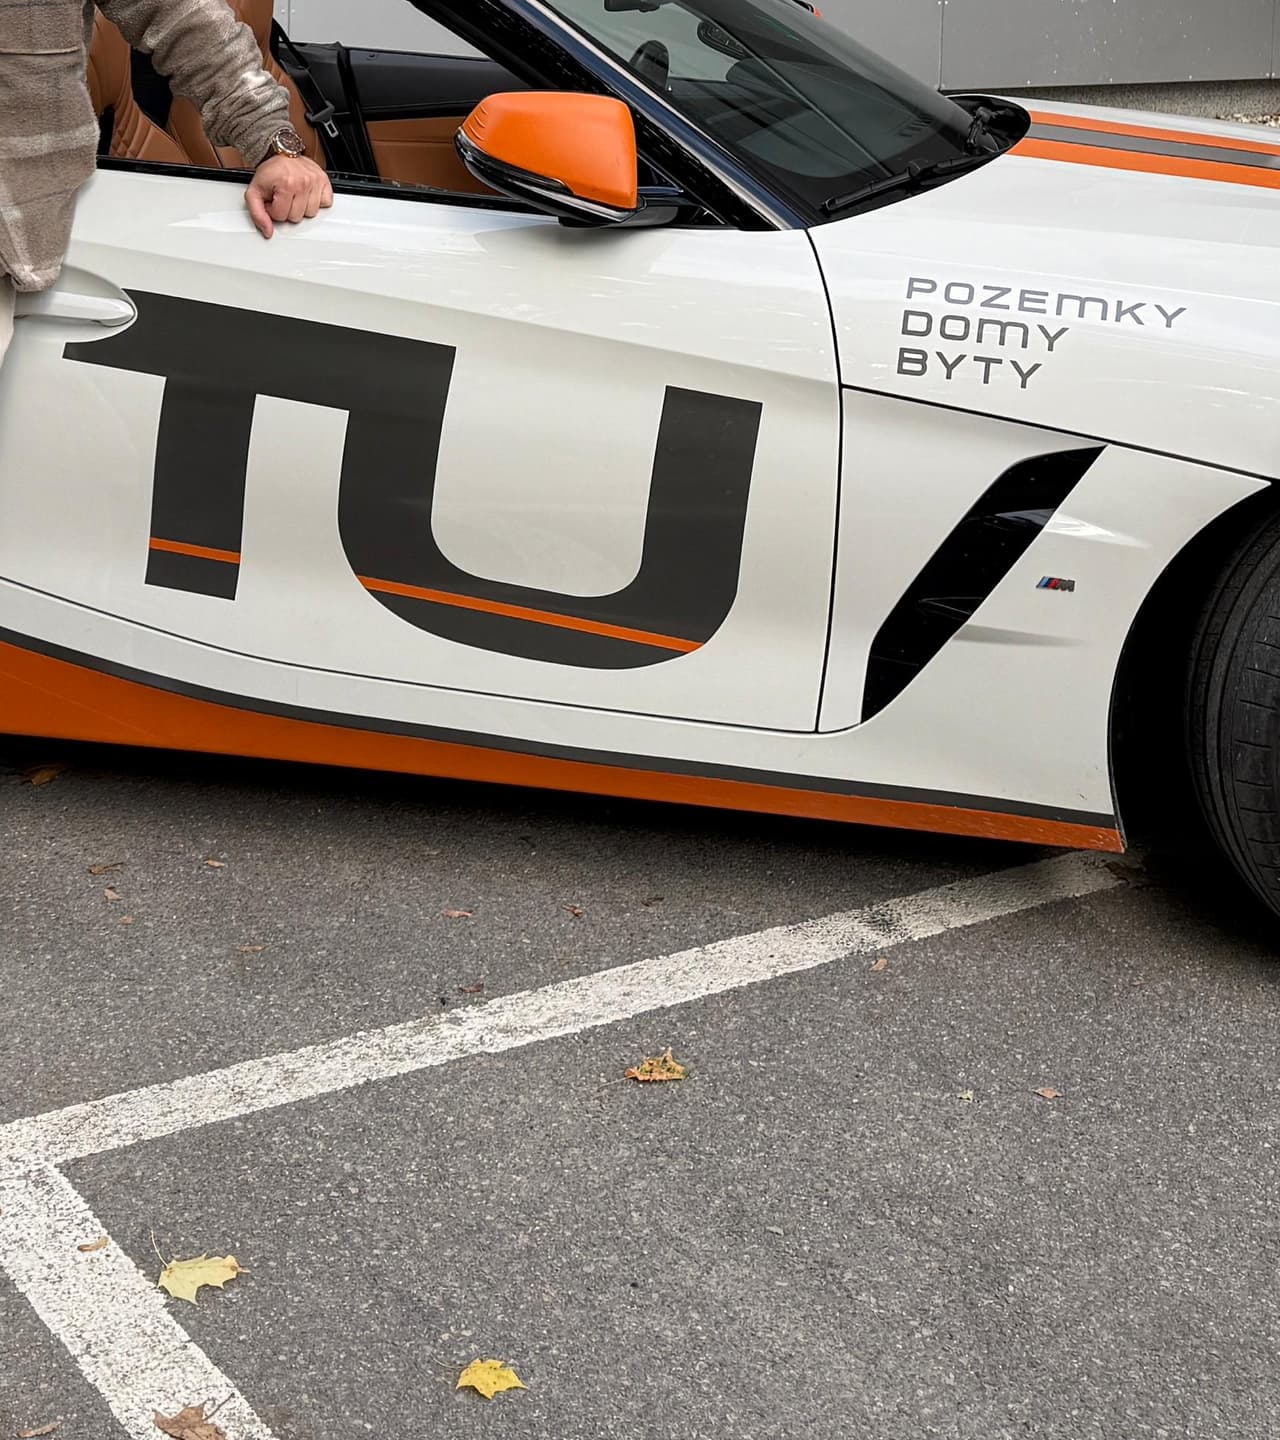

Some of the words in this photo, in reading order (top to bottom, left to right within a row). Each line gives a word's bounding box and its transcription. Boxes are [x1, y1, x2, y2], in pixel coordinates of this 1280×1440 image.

[906, 277, 1187, 328] POZEMKY
[901, 309, 1069, 351] DOMY
[897, 347, 1042, 389] BYTY
[62, 288, 763, 670] TU
